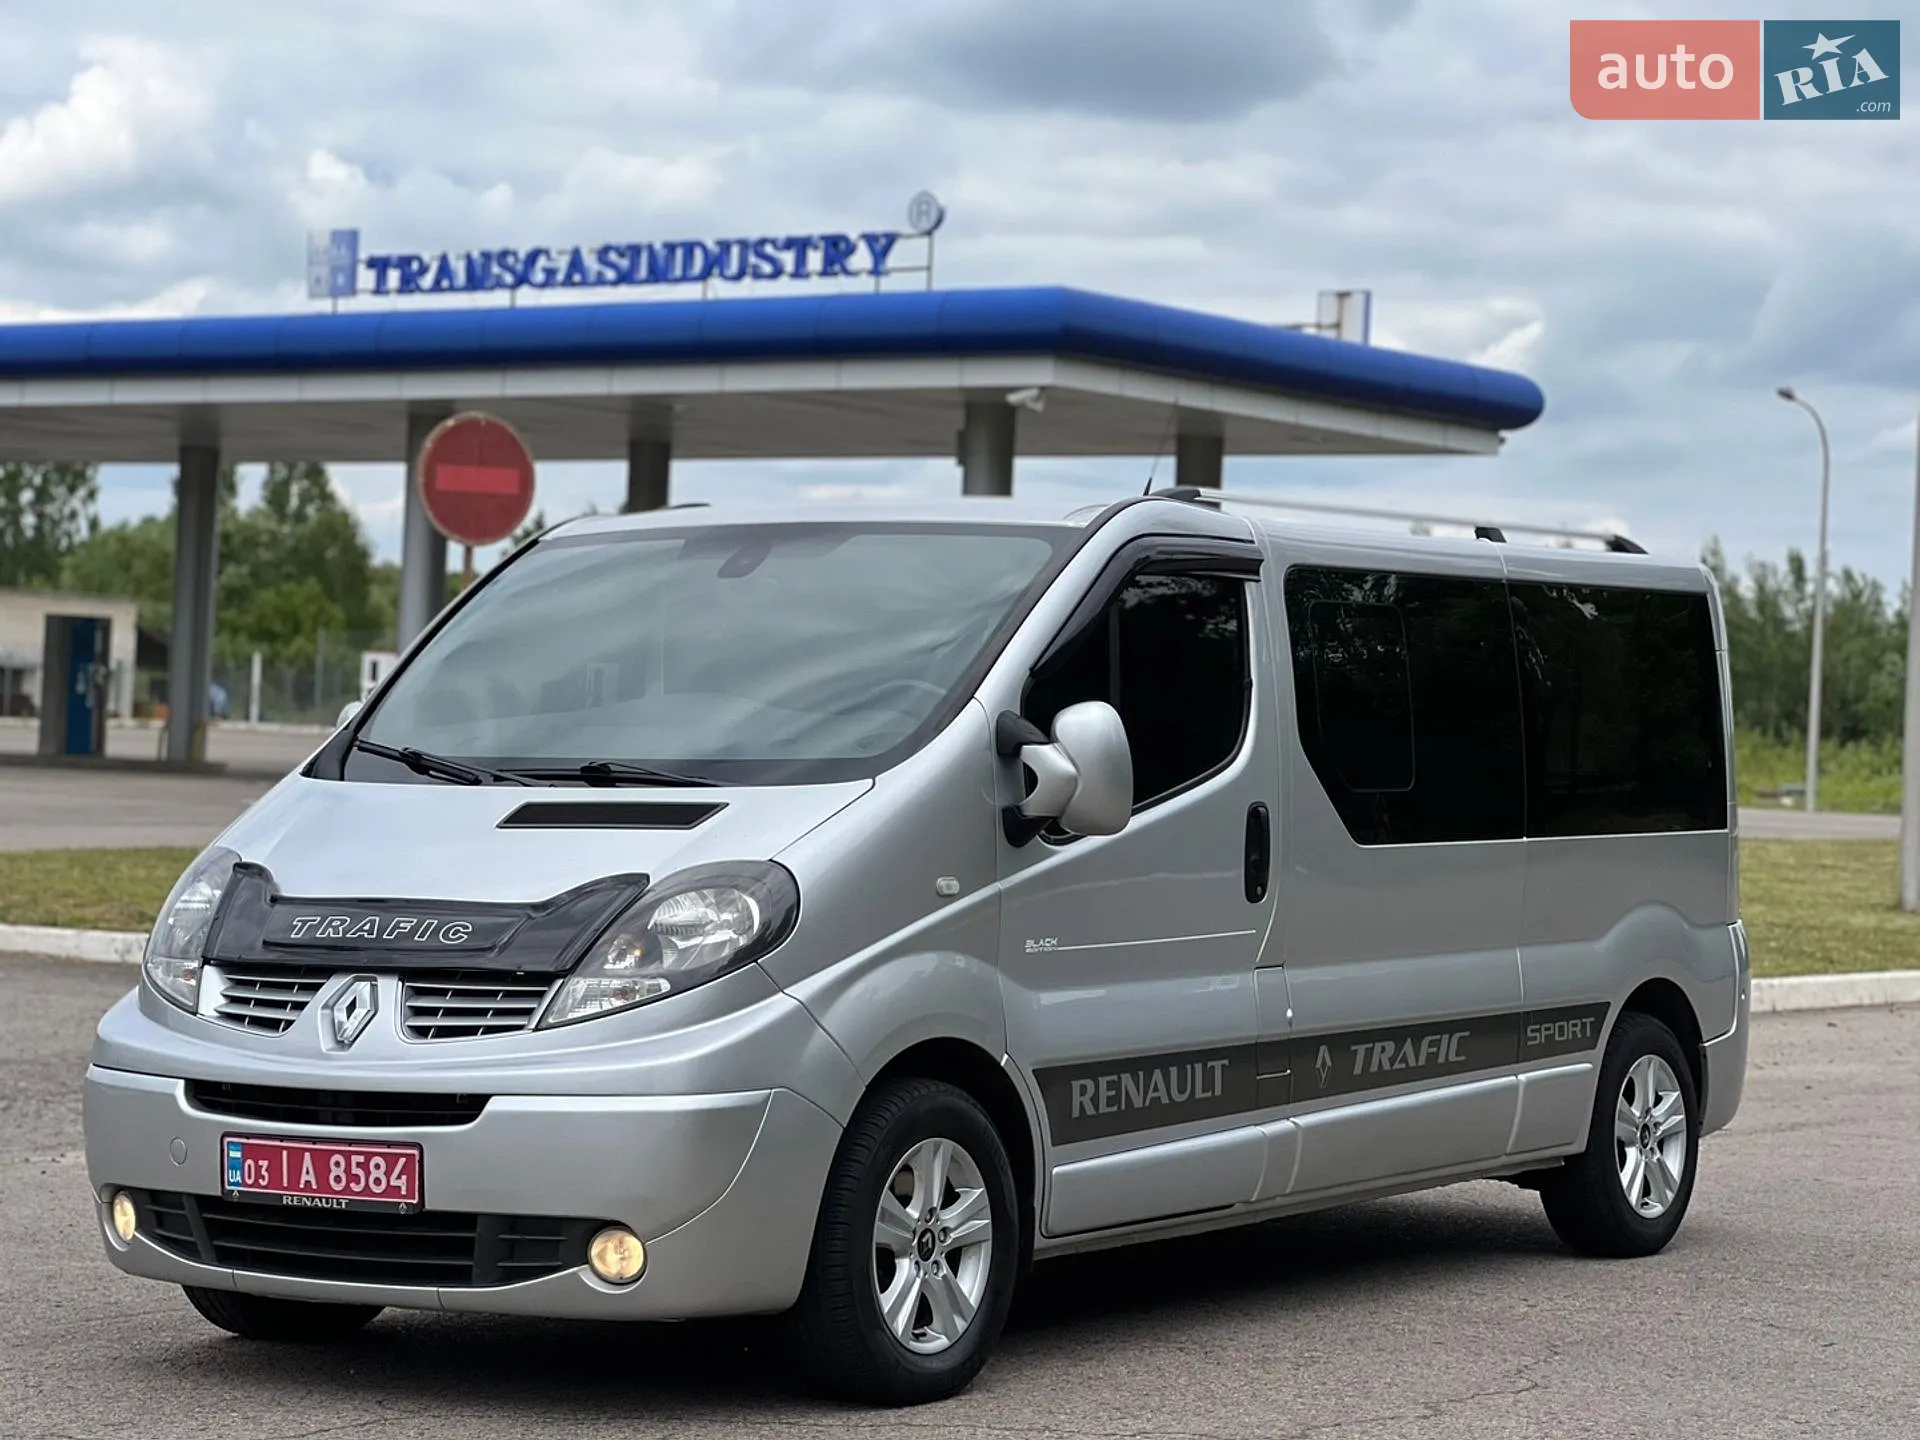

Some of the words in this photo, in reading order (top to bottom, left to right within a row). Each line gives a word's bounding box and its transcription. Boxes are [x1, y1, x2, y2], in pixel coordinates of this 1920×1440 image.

[365, 231, 901, 296] TRANSGASINDUSTRY
[290, 915, 472, 945] TRAFIC
[1024, 937, 1059, 948] BLACK
[1070, 1059, 1229, 1119] RENAULT
[1350, 1030, 1470, 1076] TRAFIC
[1526, 1017, 1595, 1046] SPORT
[229, 1169, 242, 1183] UA
[244, 1158, 269, 1187] 03
[329, 1153, 408, 1195] 8584
[282, 1195, 349, 1209] RENAULT
